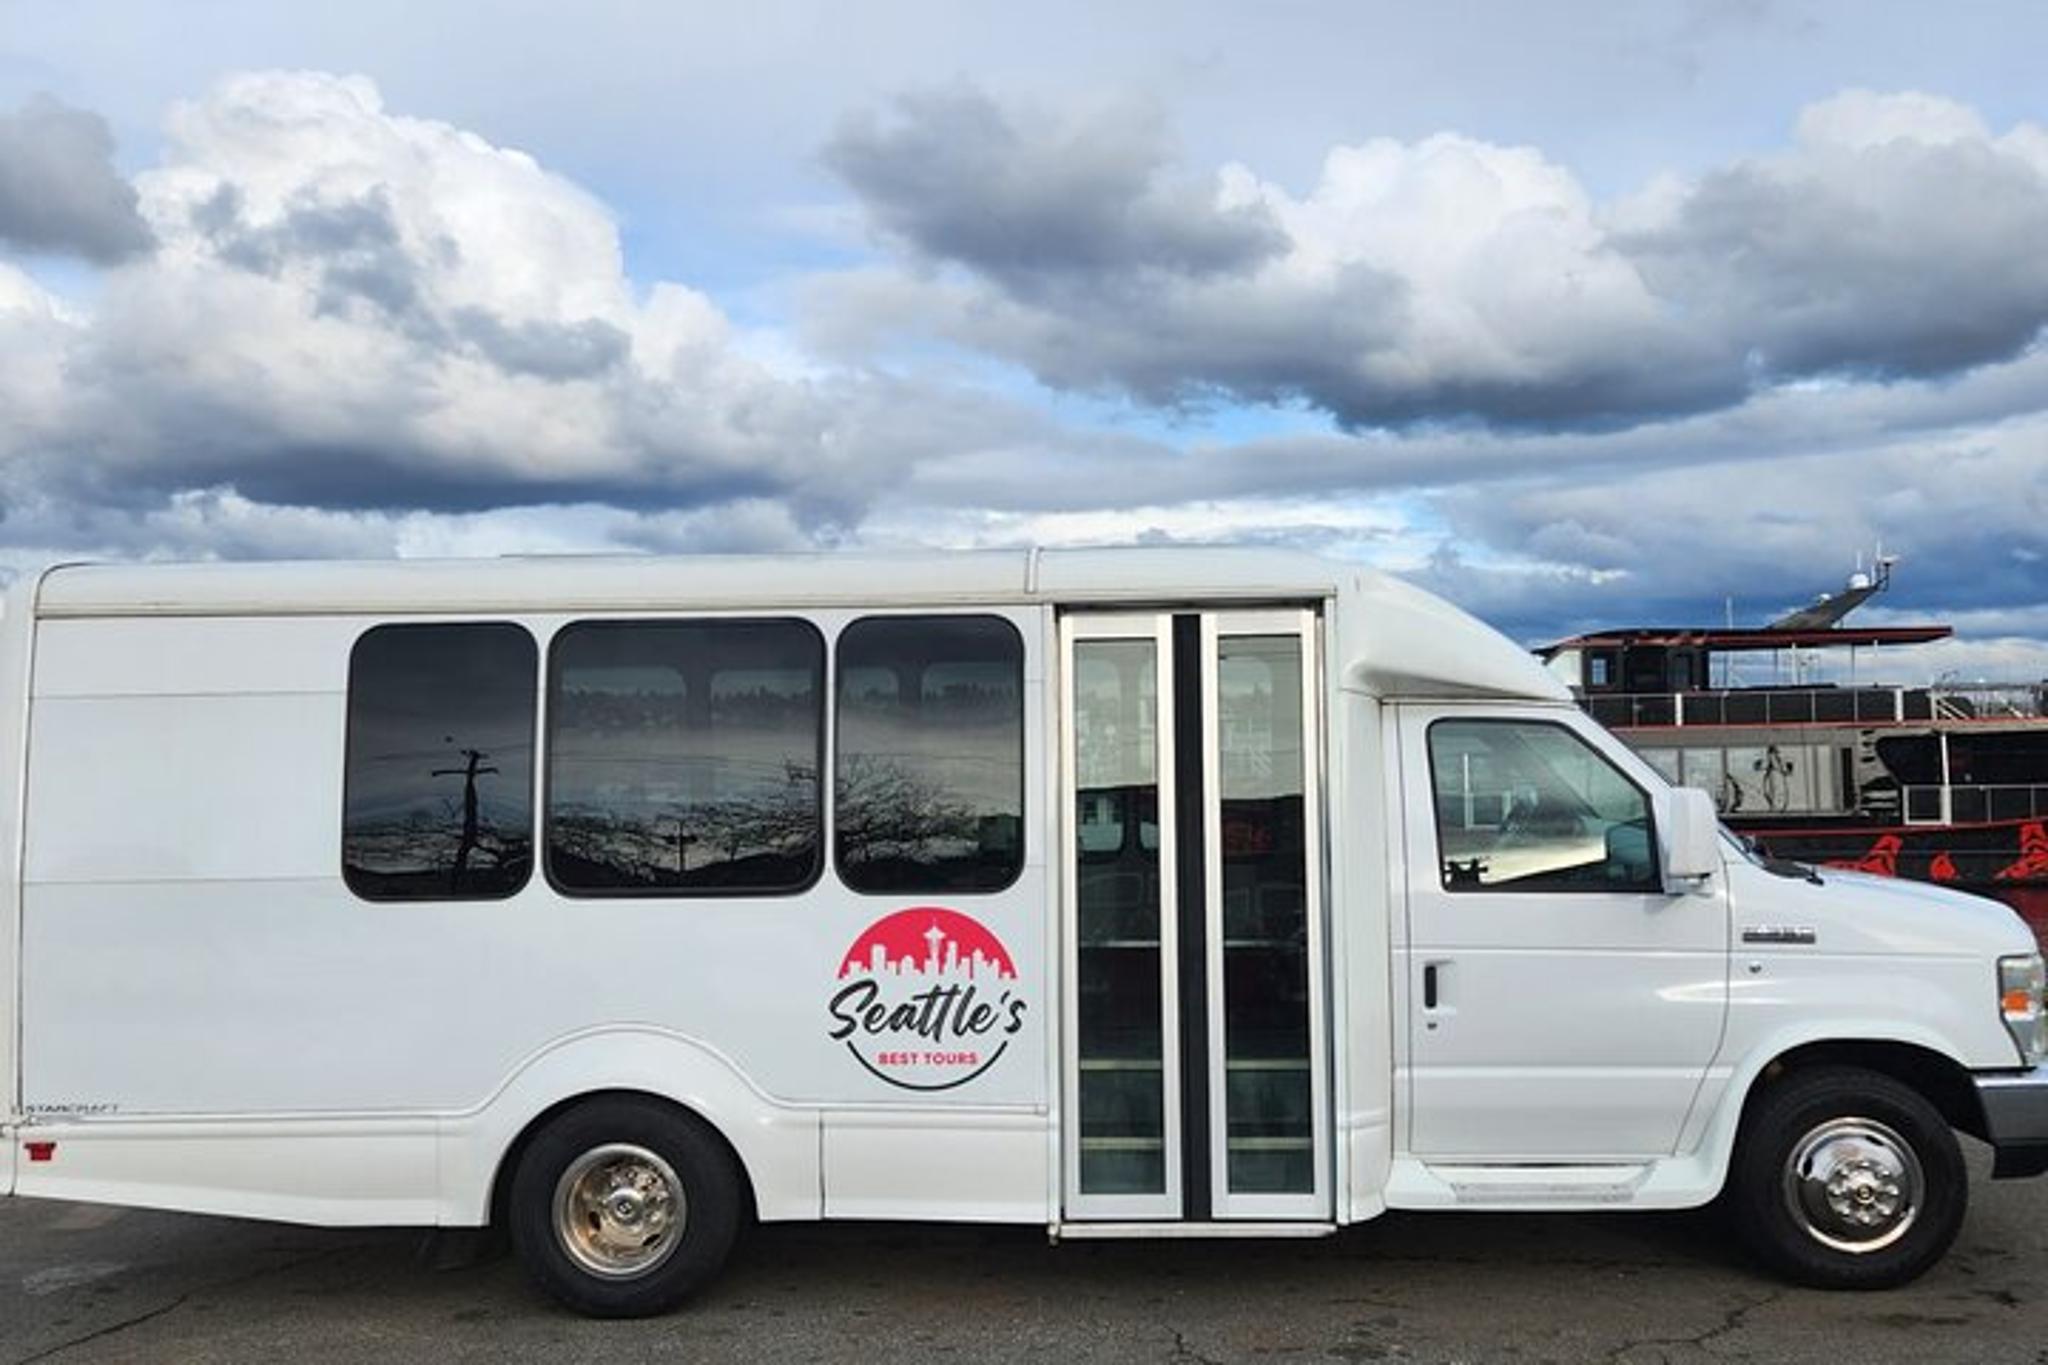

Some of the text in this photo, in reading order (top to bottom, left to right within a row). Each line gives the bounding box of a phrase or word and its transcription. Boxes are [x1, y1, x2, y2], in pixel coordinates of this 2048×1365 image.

[828, 979, 1027, 1043] Seattle's
[878, 1052, 978, 1065] BEST TOURS
